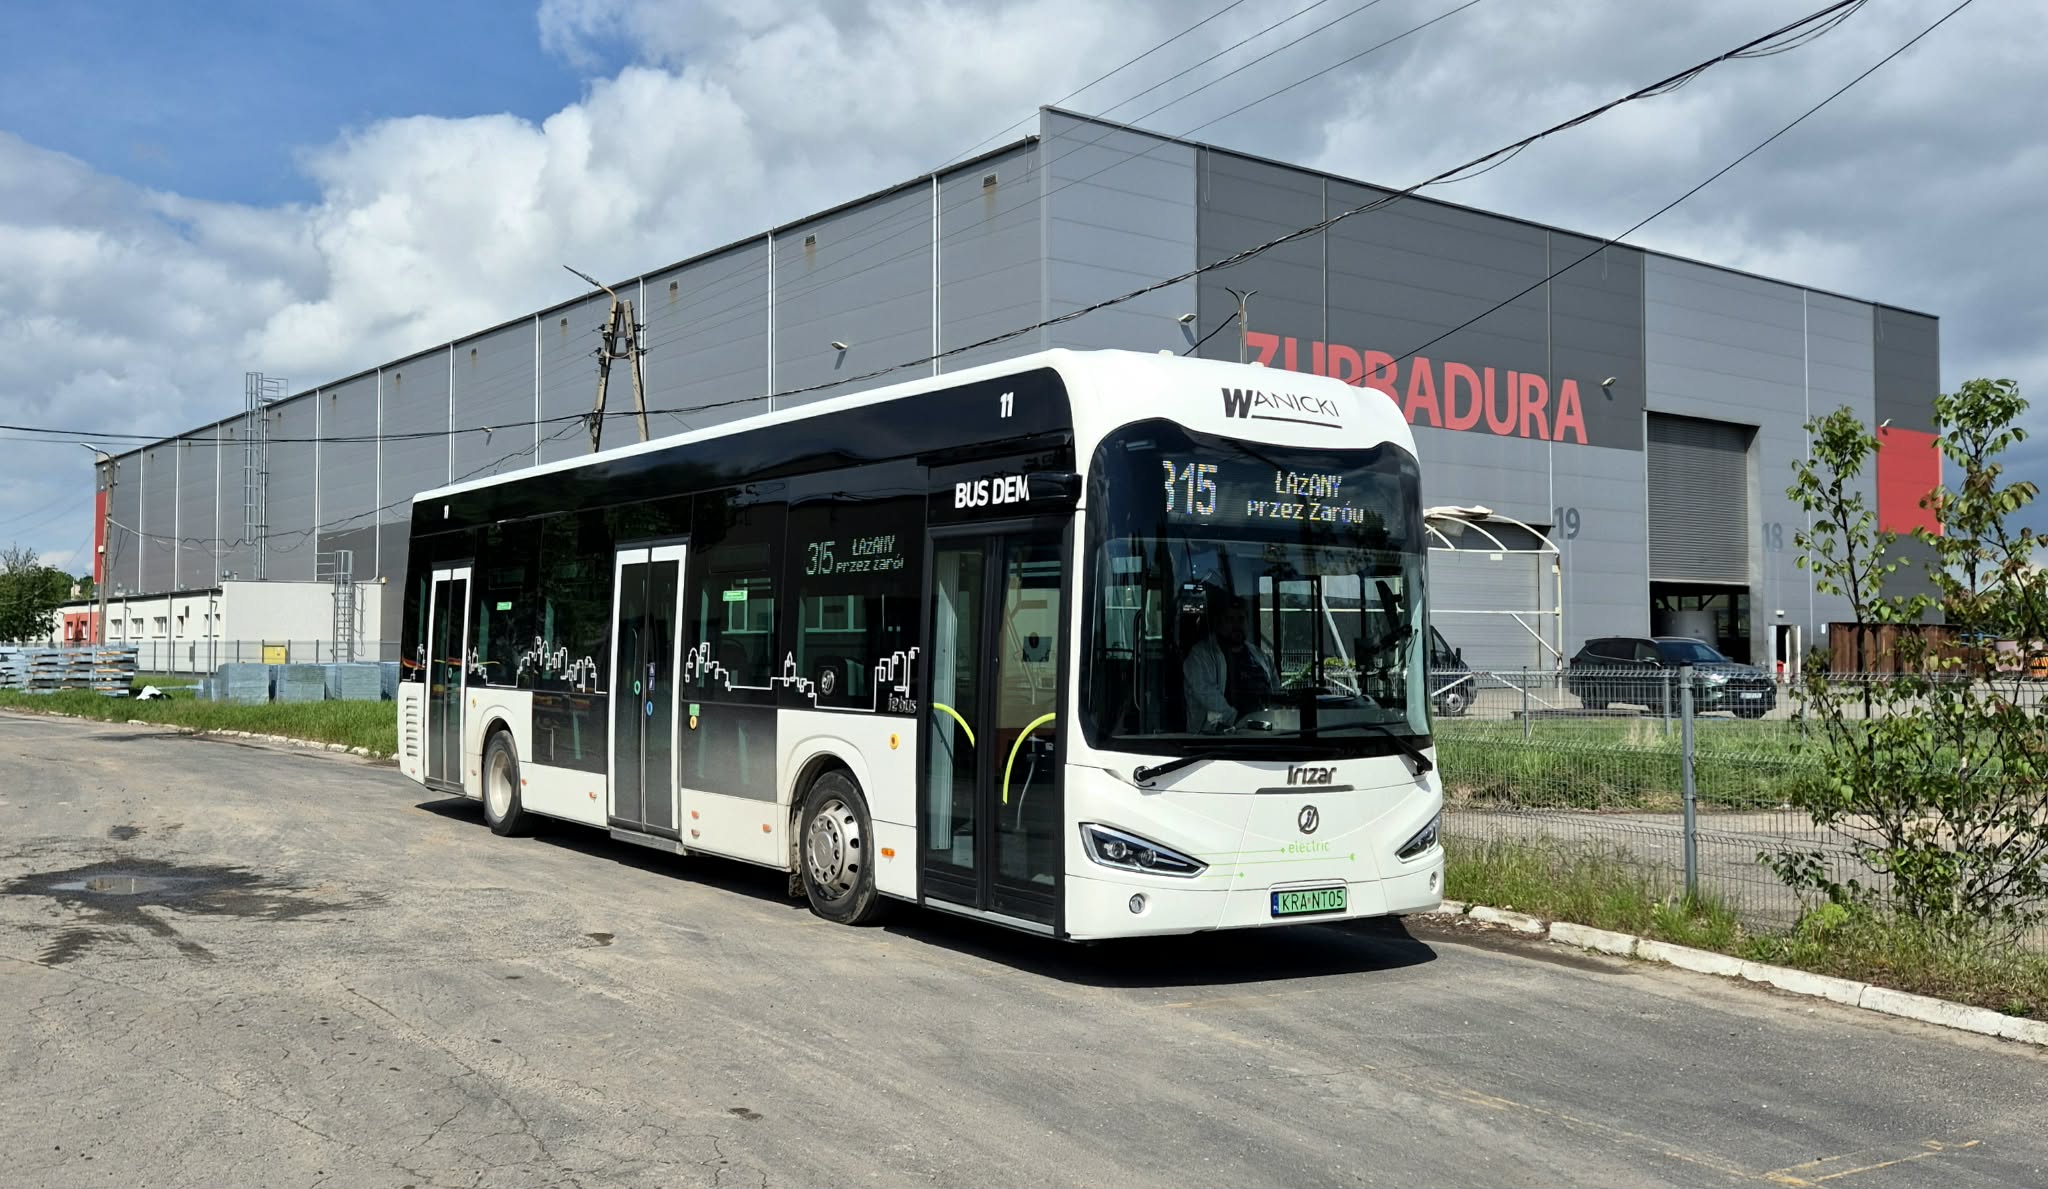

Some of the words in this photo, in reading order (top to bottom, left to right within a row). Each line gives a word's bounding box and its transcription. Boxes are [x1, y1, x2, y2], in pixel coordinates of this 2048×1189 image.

[1000, 391, 1014, 418] 11
[1221, 387, 1340, 419] WANICKI
[954, 479, 990, 509] BUS
[1247, 500, 1304, 520] przez
[1553, 506, 1581, 540] 19
[1762, 521, 1784, 552] 18
[805, 540, 836, 575] 315
[1288, 840, 1330, 854] electric
[1282, 893, 1308, 912] KRA
[1311, 889, 1344, 909] NT05
